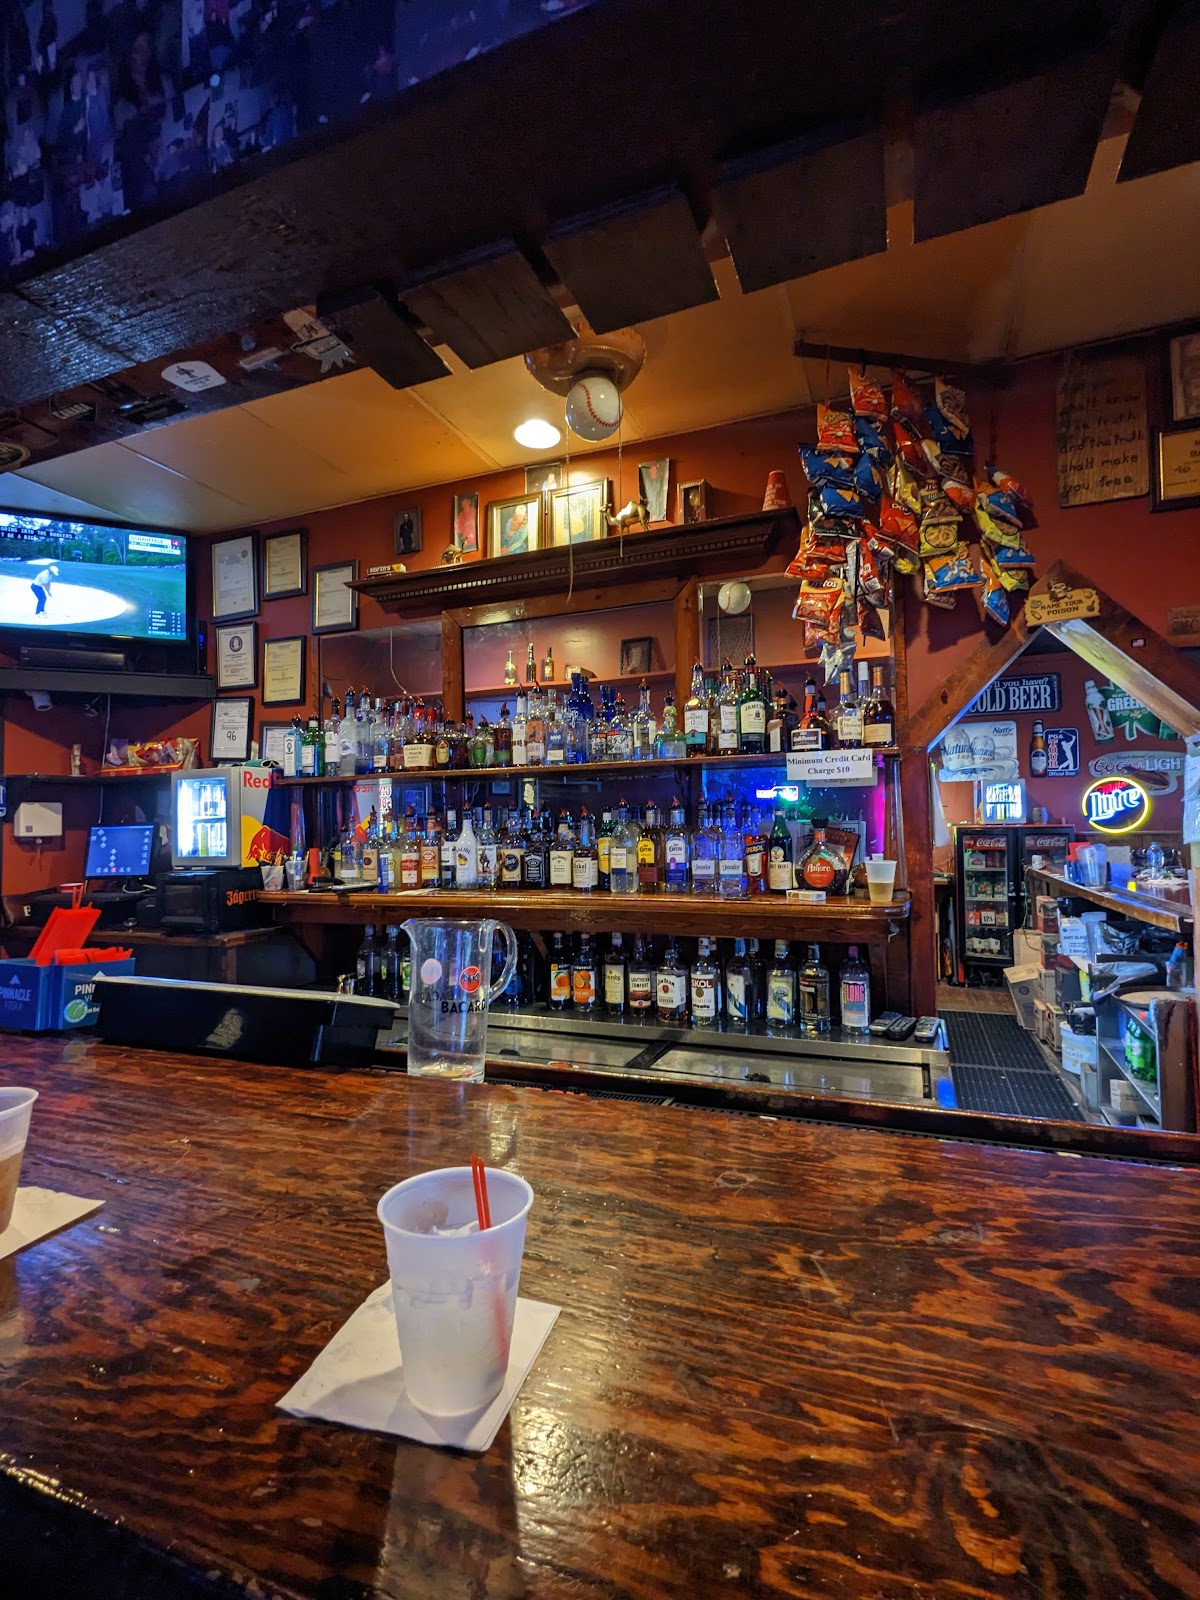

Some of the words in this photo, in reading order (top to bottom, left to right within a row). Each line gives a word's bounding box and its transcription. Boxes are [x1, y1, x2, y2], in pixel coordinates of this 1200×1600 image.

[1064, 599, 1085, 607] YOUR
[1046, 606, 1080, 616] POISON
[1002, 681, 1020, 689] you
[1022, 677, 1049, 686] have?
[1008, 684, 1053, 711] BEER
[227, 730, 237, 742] 96
[788, 757, 823, 765] Minimum
[825, 755, 850, 764] Credit
[851, 753, 871, 763] Card
[1047, 739, 1058, 769] TOUR
[837, 766, 850, 774] $10
[243, 770, 272, 789] Red
